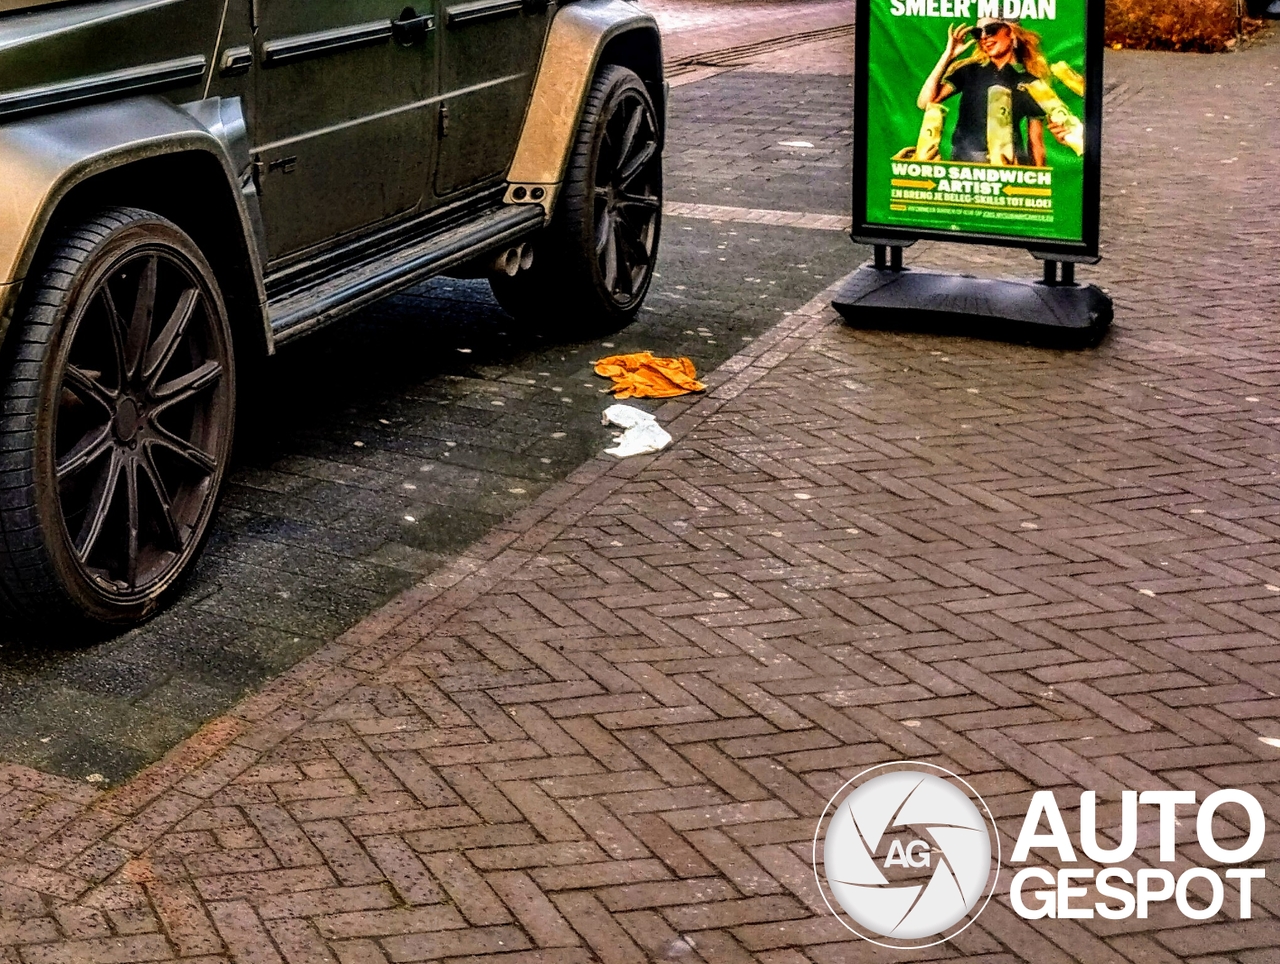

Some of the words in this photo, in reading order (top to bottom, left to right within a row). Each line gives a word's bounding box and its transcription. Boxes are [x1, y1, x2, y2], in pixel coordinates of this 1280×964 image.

[891, 163, 946, 178] WORD
[948, 167, 1052, 185] SANDWICH
[937, 180, 1002, 195] ARTIST
[903, 190, 933, 200] BRENG
[1007, 197, 1023, 206] TOT
